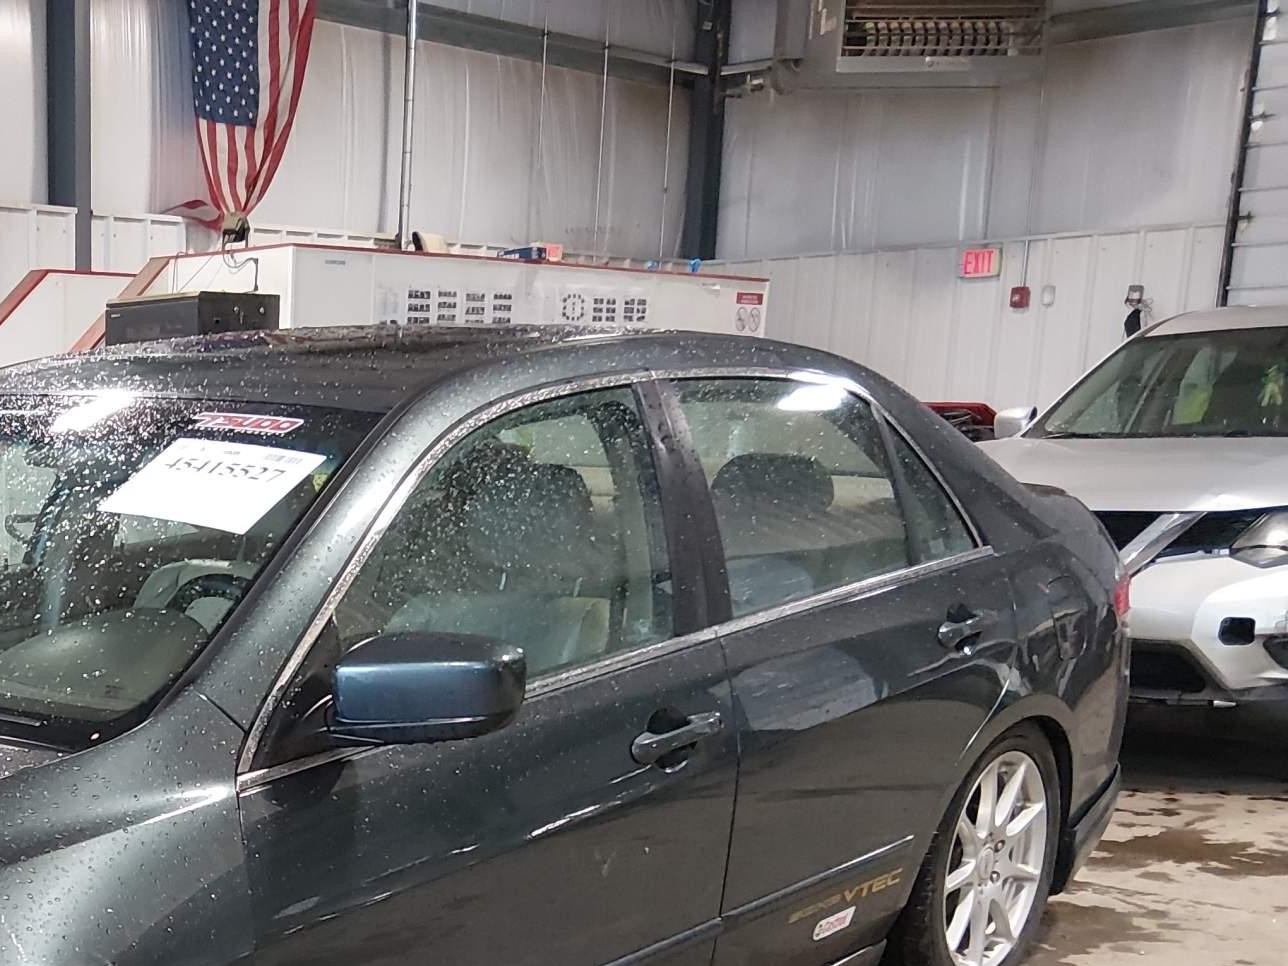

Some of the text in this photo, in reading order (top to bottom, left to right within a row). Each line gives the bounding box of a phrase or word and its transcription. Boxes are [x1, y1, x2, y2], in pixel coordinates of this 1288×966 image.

[964, 250, 994, 275] EXIT
[165, 457, 287, 482] 45415527
[843, 867, 904, 903] VTEC
